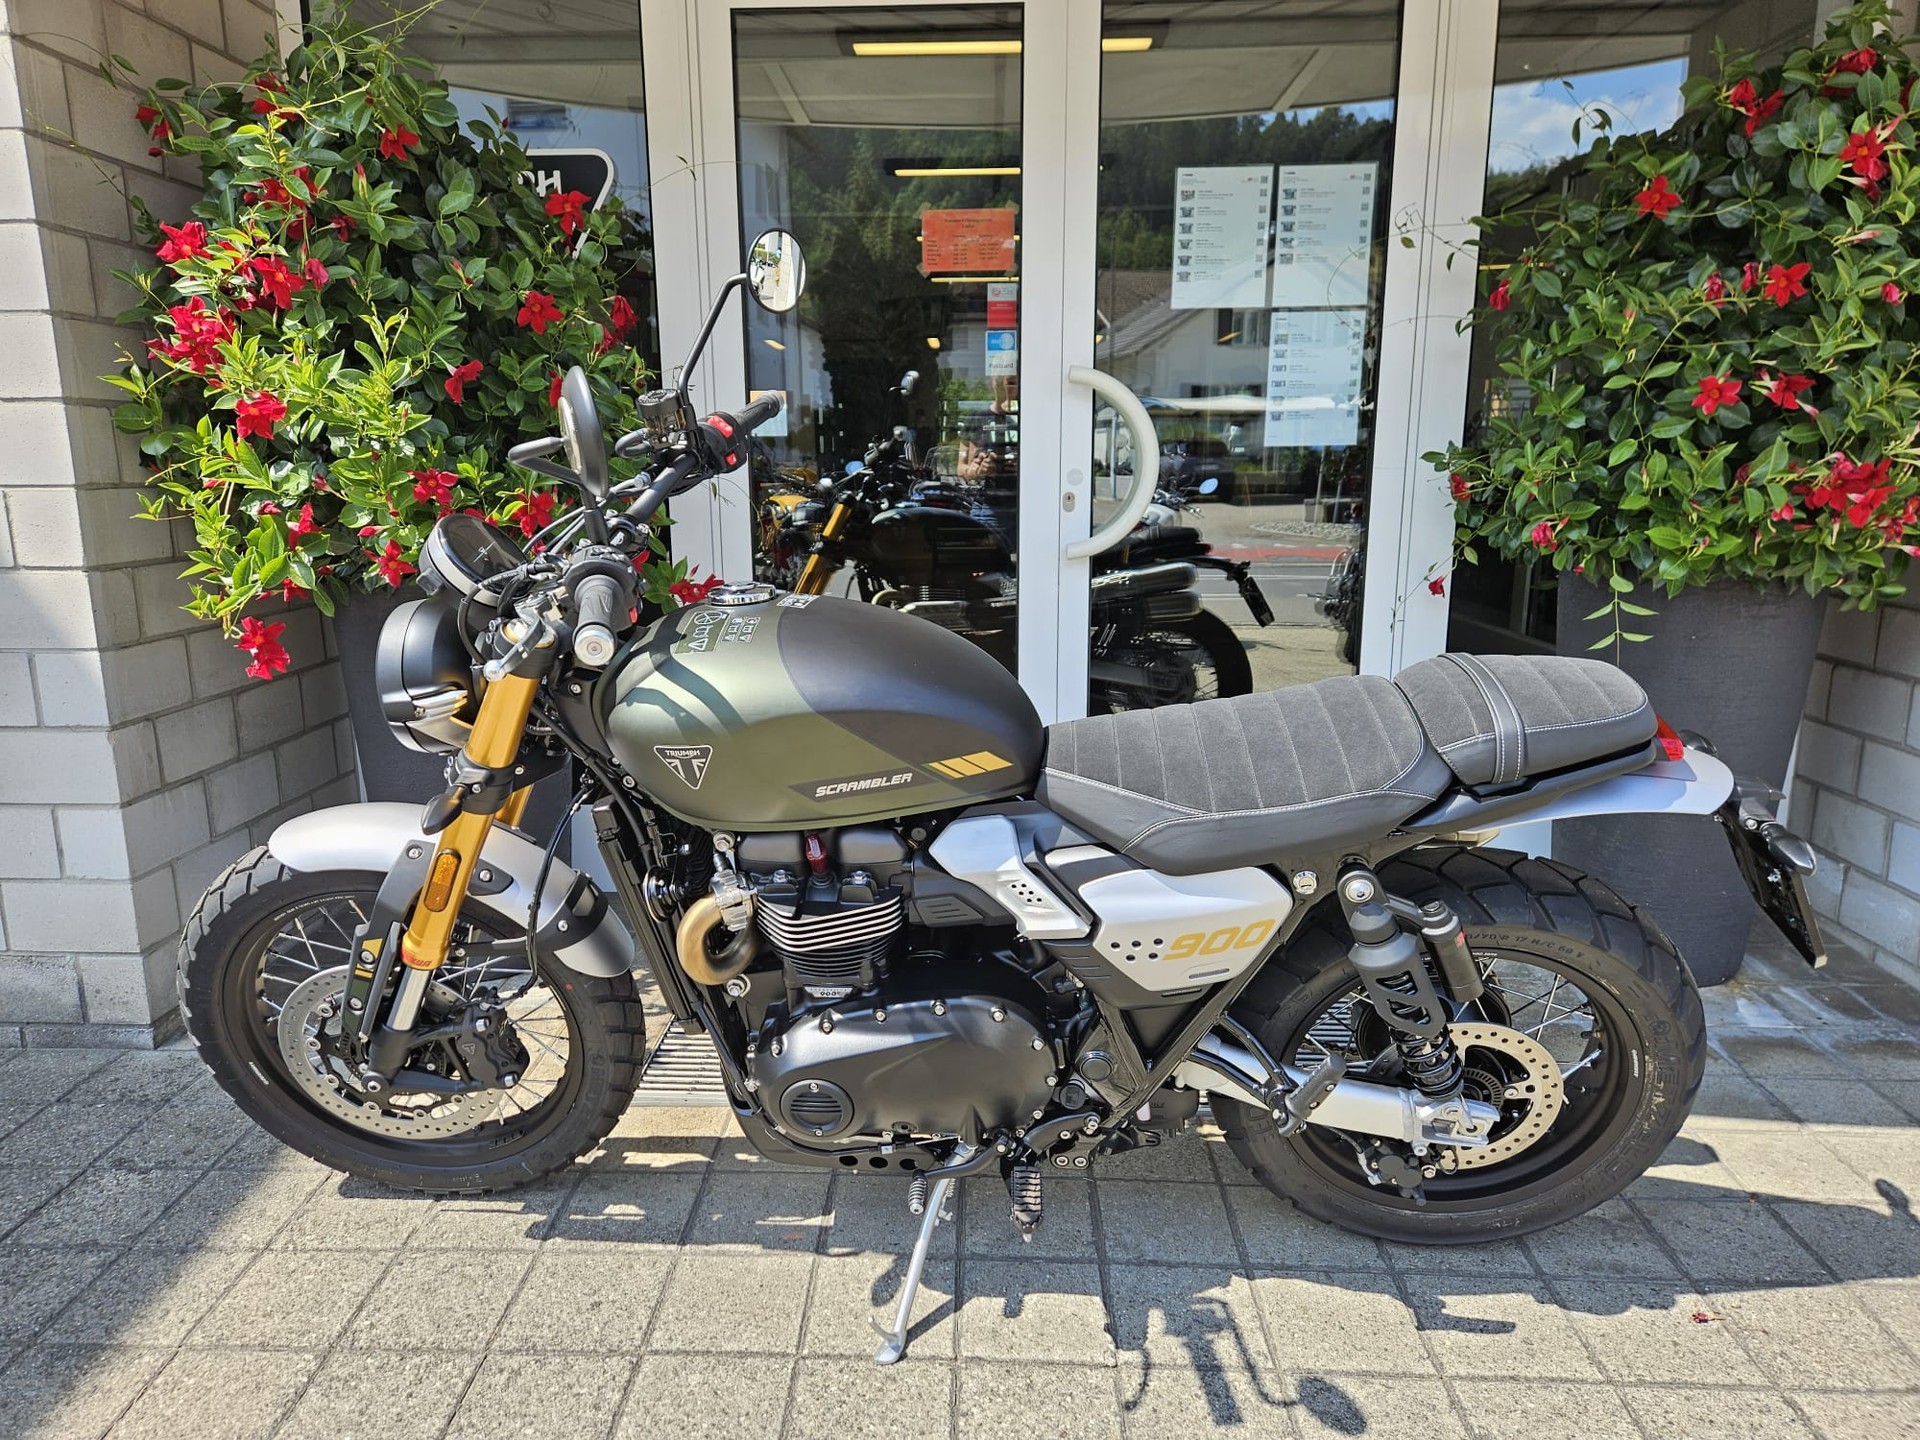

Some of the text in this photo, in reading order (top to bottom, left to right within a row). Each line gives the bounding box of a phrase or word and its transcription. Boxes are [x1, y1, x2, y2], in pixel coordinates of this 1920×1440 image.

[665, 749, 701, 757] TRIUMPH
[815, 772, 913, 797] SCRAMBLER
[1162, 919, 1275, 961] 900
